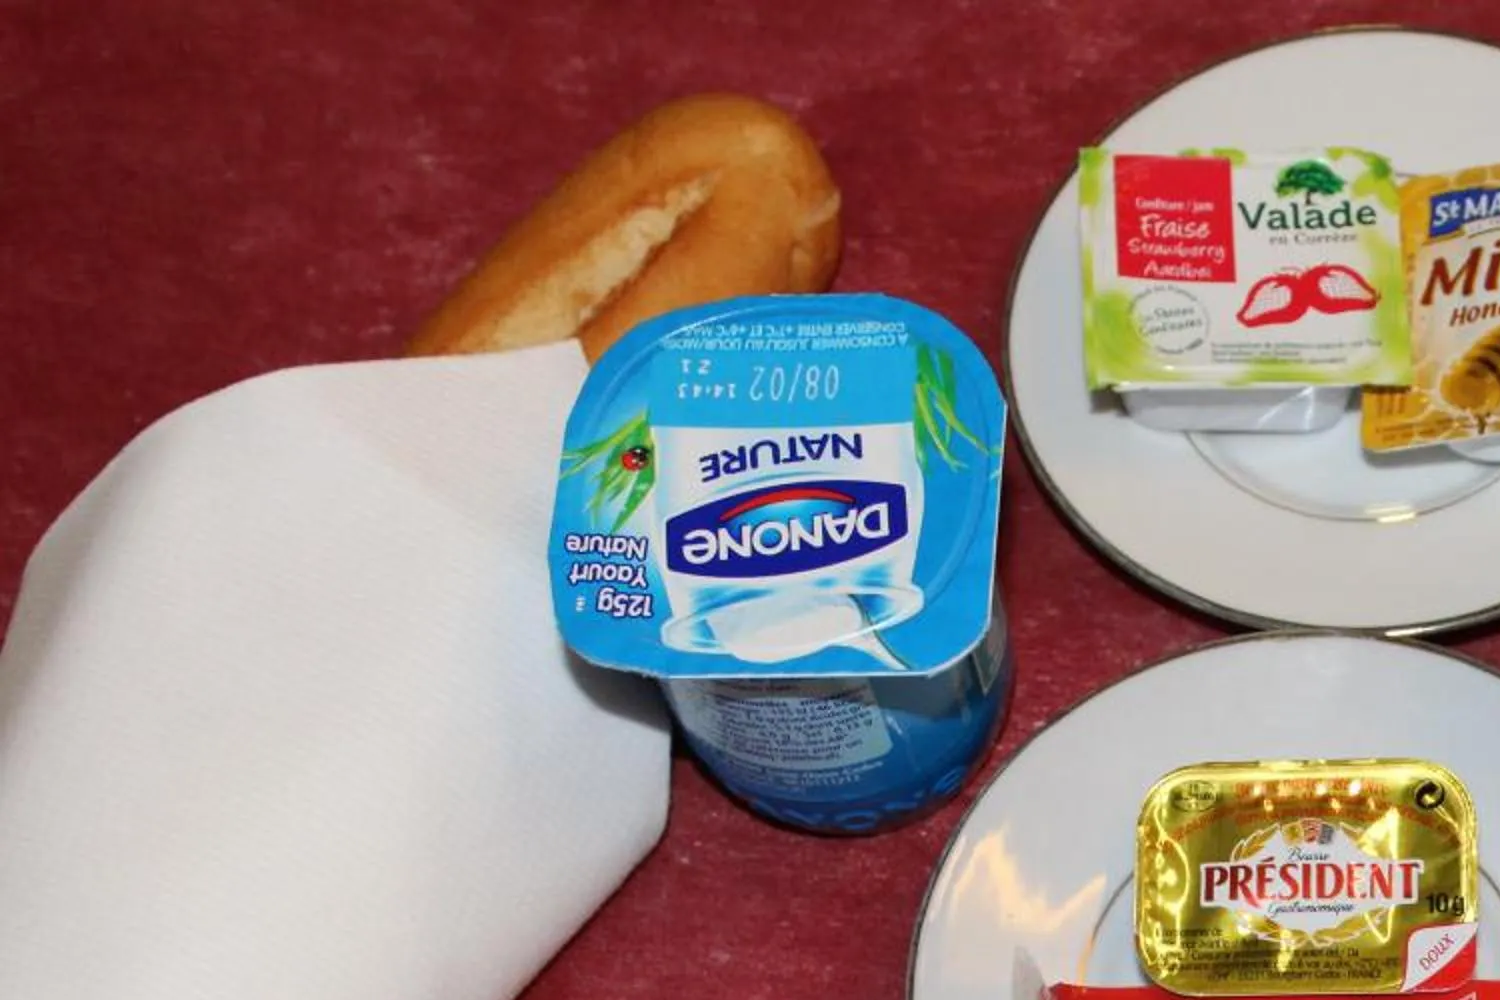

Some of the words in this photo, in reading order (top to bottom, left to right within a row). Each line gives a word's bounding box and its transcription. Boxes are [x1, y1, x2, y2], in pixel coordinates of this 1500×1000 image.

[1140, 213, 1212, 239] Fraise
[1237, 199, 1378, 230] Valade
[1433, 200, 1460, 226] St
[1126, 237, 1225, 264] Strawberry
[750, 363, 840, 403] 08/02
[700, 433, 863, 483] NATURE
[565, 533, 648, 560] Nature
[683, 502, 890, 565] DANONE
[568, 562, 648, 588] Yaourt
[596, 586, 653, 618] 125g
[1203, 857, 1420, 908] PRÉSIDENT
[1426, 892, 1449, 914] 10
[1419, 933, 1455, 970] DOUX
